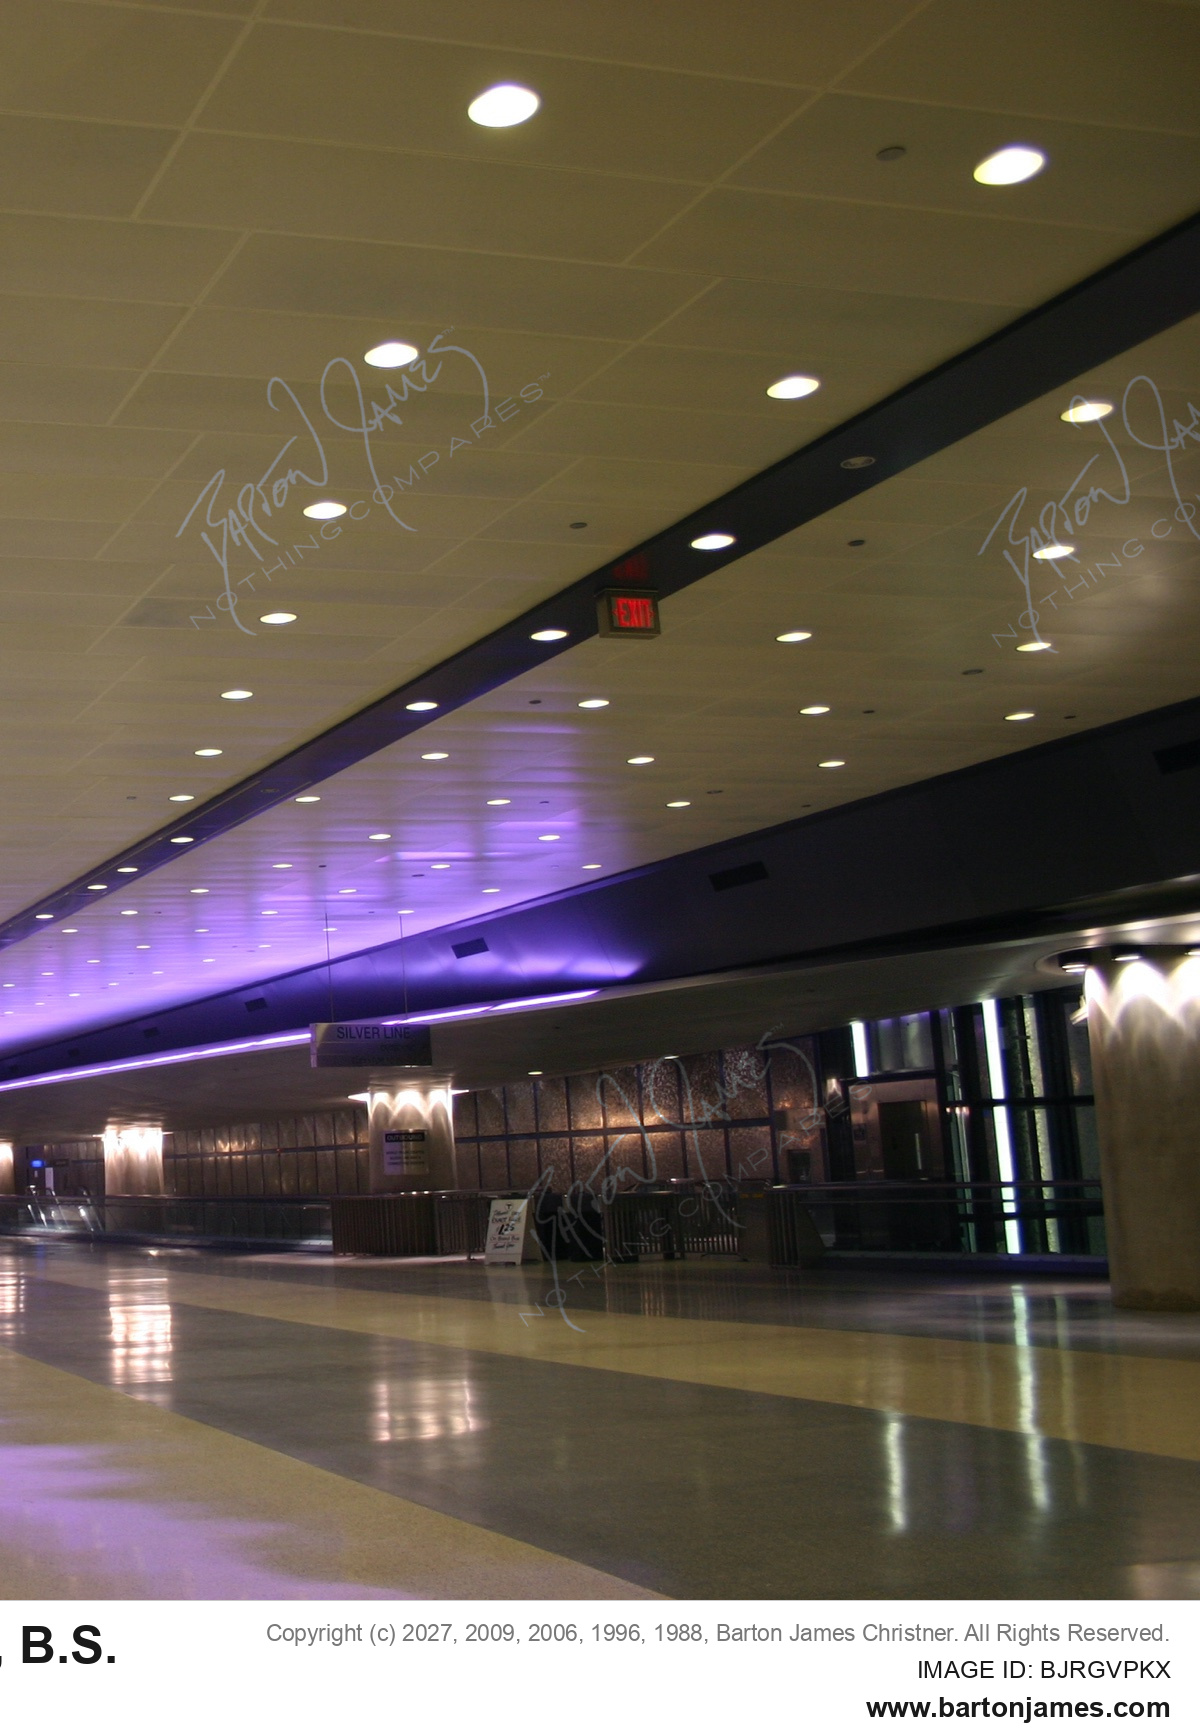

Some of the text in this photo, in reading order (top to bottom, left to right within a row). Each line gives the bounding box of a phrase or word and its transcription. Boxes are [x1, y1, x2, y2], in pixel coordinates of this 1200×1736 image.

[616, 597, 652, 628] EXIT
[336, 1026, 411, 1039] SILVER LINE
